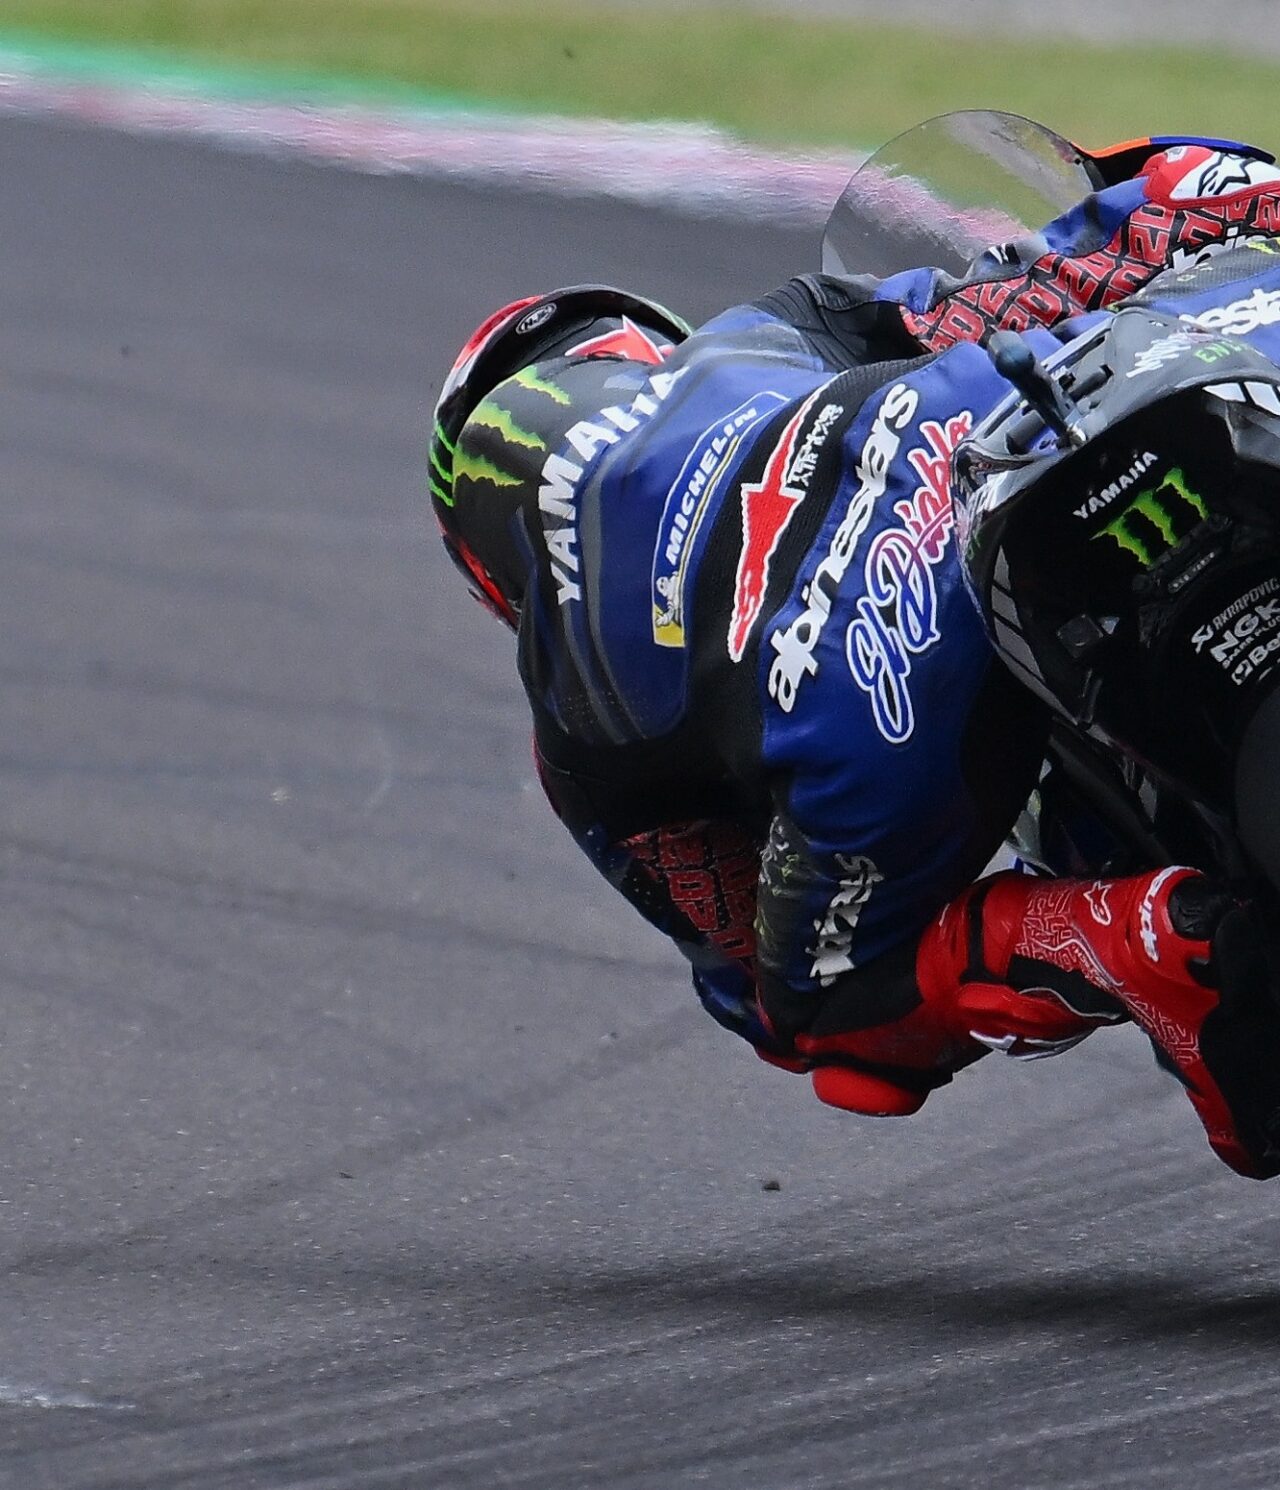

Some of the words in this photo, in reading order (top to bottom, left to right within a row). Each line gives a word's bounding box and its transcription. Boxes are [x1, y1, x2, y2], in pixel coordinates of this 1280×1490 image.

[538, 366, 691, 605] YAMAHA
[665, 407, 758, 566] MICHELIN
[767, 382, 919, 713] alpinestars
[1072, 451, 1158, 519] YAMAHA
